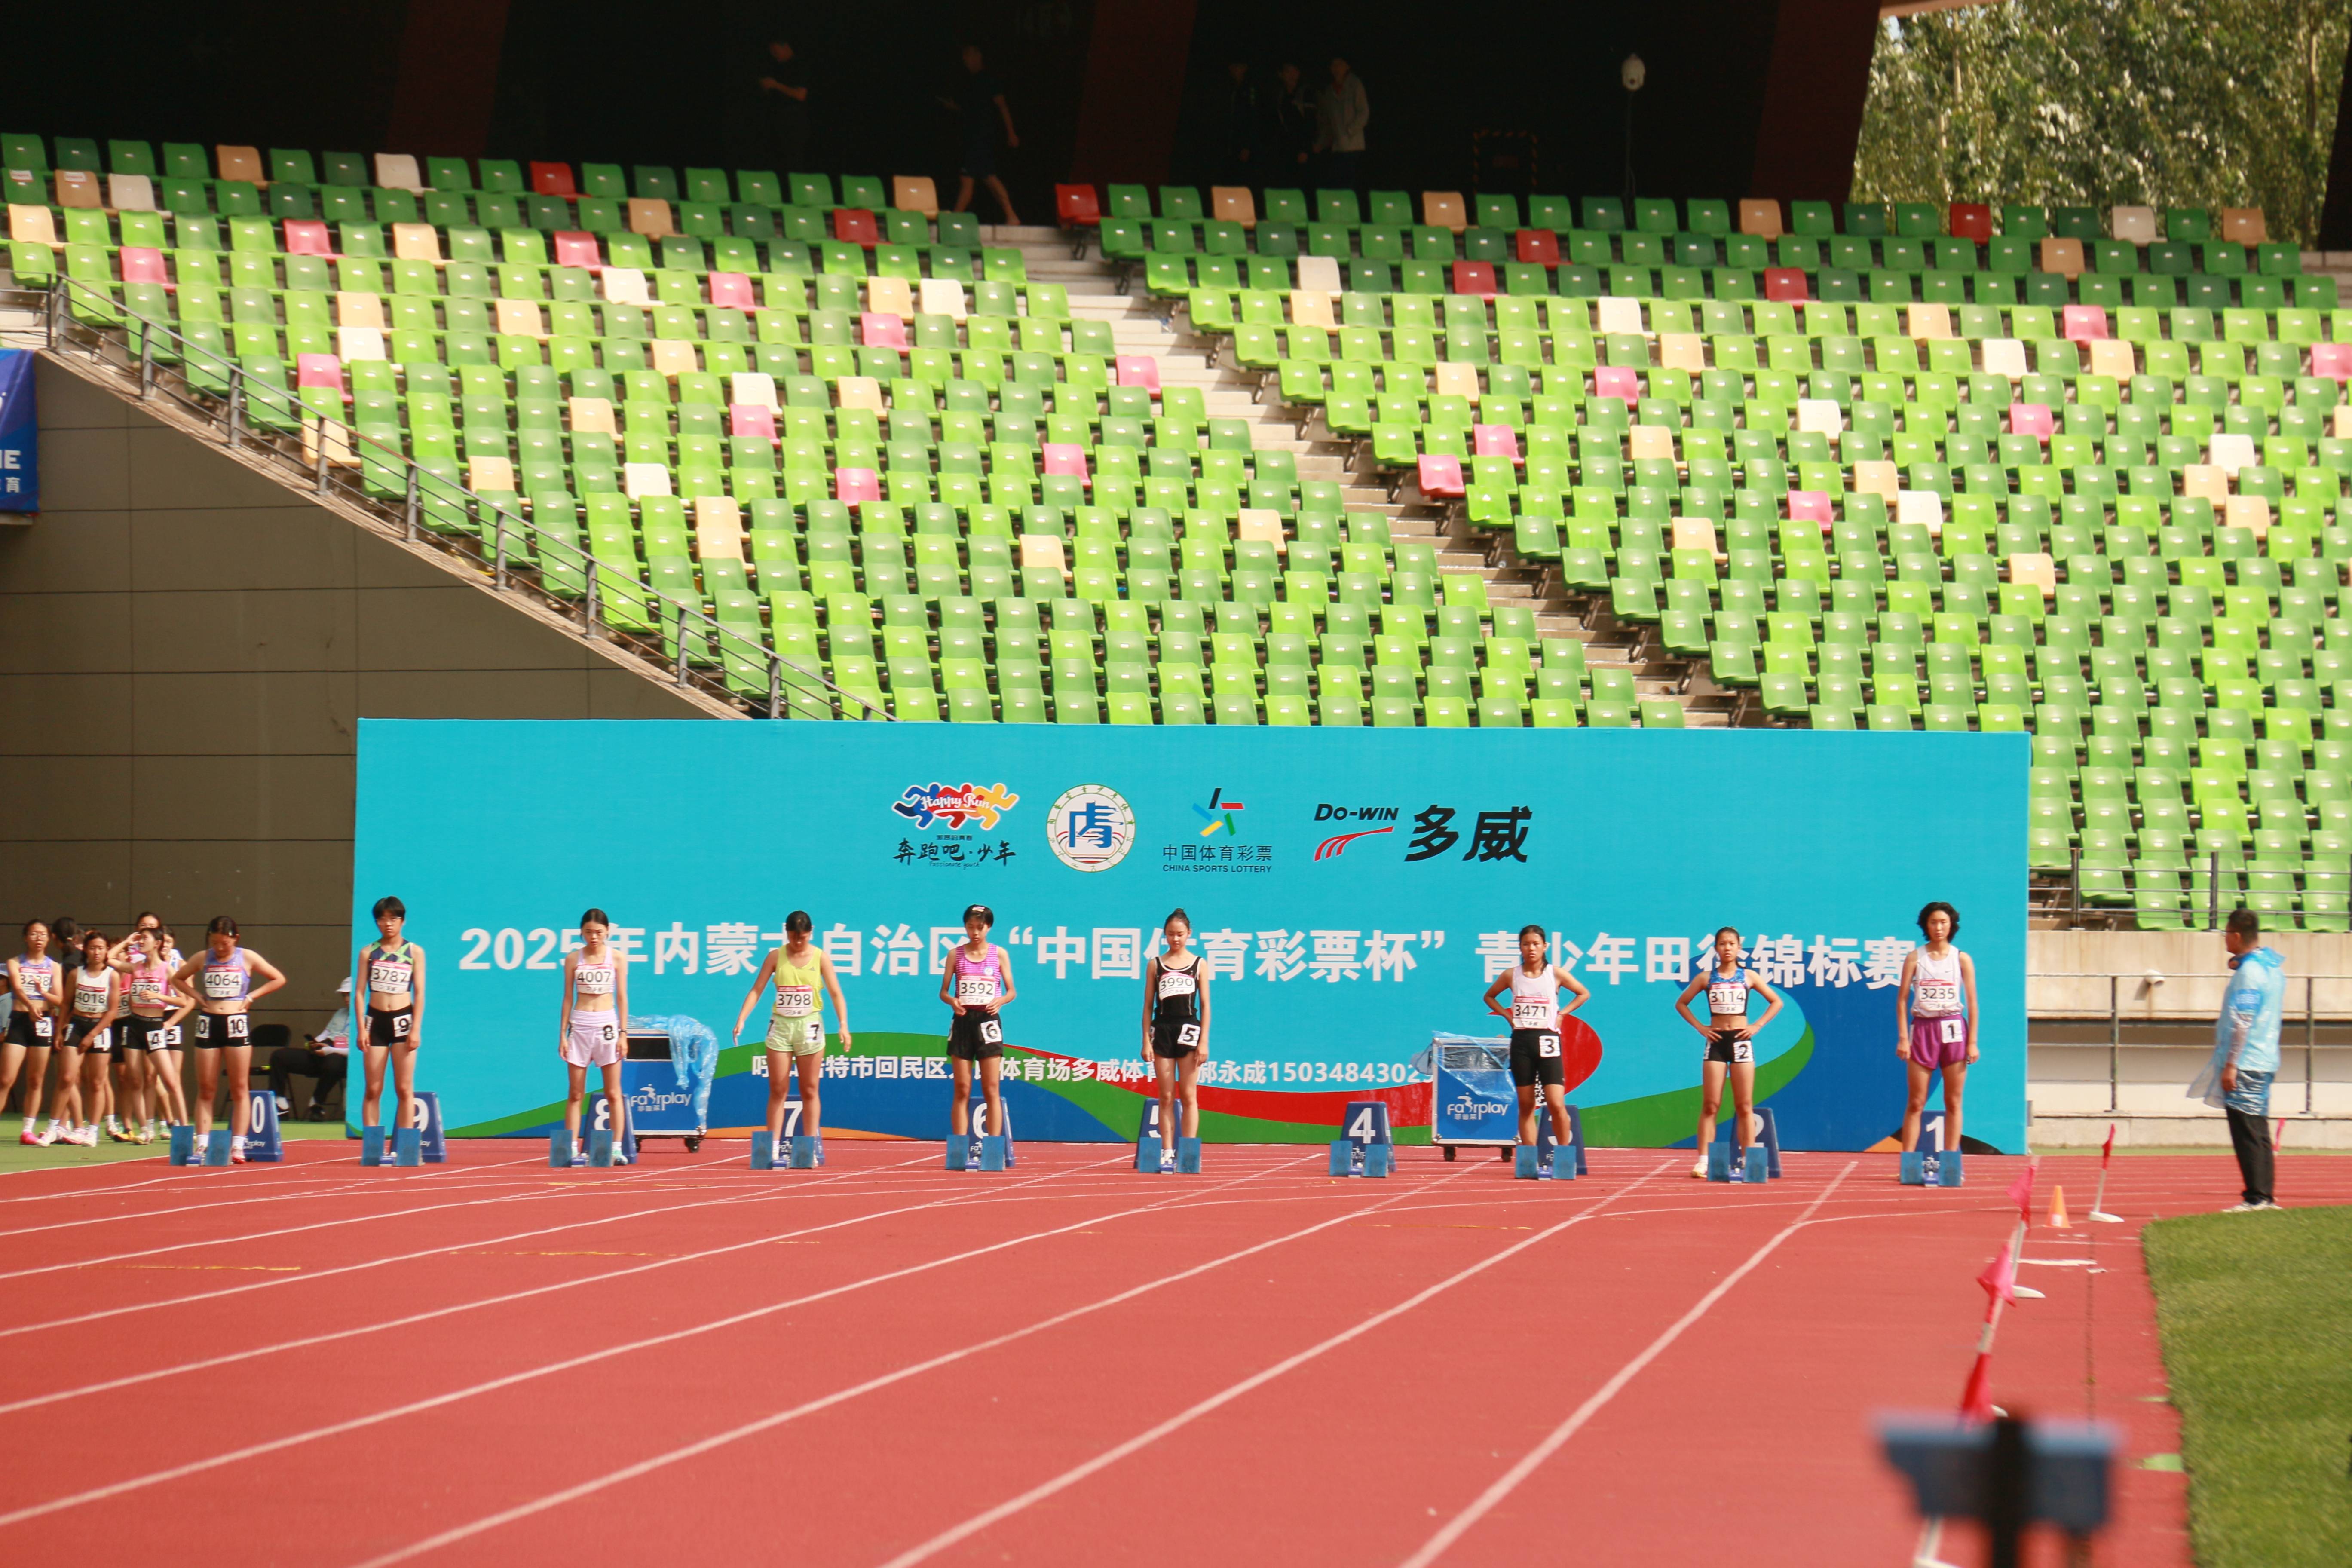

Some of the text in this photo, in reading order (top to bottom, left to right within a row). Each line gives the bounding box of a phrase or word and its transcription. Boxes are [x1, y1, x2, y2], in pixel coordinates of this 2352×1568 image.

[0, 449, 21, 469] E
[0, 477, 20, 493] 育
[920, 793, 990, 811] Happy Run
[1403, 804, 1533, 863] 多威
[1163, 844, 1272, 861] 中国体育彩票
[1193, 864, 1229, 873] SPORTS
[206, 974, 239, 986] 4064
[372, 968, 407, 983] 3787
[577, 971, 611, 983] 4007
[960, 982, 993, 995] 3592
[1161, 977, 1193, 991] 3990
[77, 993, 105, 1004] 4018
[778, 994, 811, 1006] 3798
[1711, 991, 1744, 1002] 3114
[1921, 988, 1955, 999] 3235
[1515, 1004, 1546, 1017] 3471
[230, 1019, 245, 1034] 10
[399, 1018, 409, 1032] 9
[603, 1025, 614, 1040] 8
[810, 1024, 819, 1040] 7
[986, 1023, 997, 1039] 6
[1948, 1023, 1954, 1039] 1
[151, 1032, 160, 1045] 4
[1183, 1027, 1196, 1042] 5
[1545, 1038, 1555, 1054] 3
[1739, 1044, 1749, 1059] 2
[251, 1096, 265, 1133] 0
[784, 1100, 803, 1137] 7
[1348, 1107, 1376, 1144] 4
[1926, 1116, 1945, 1152] 1
